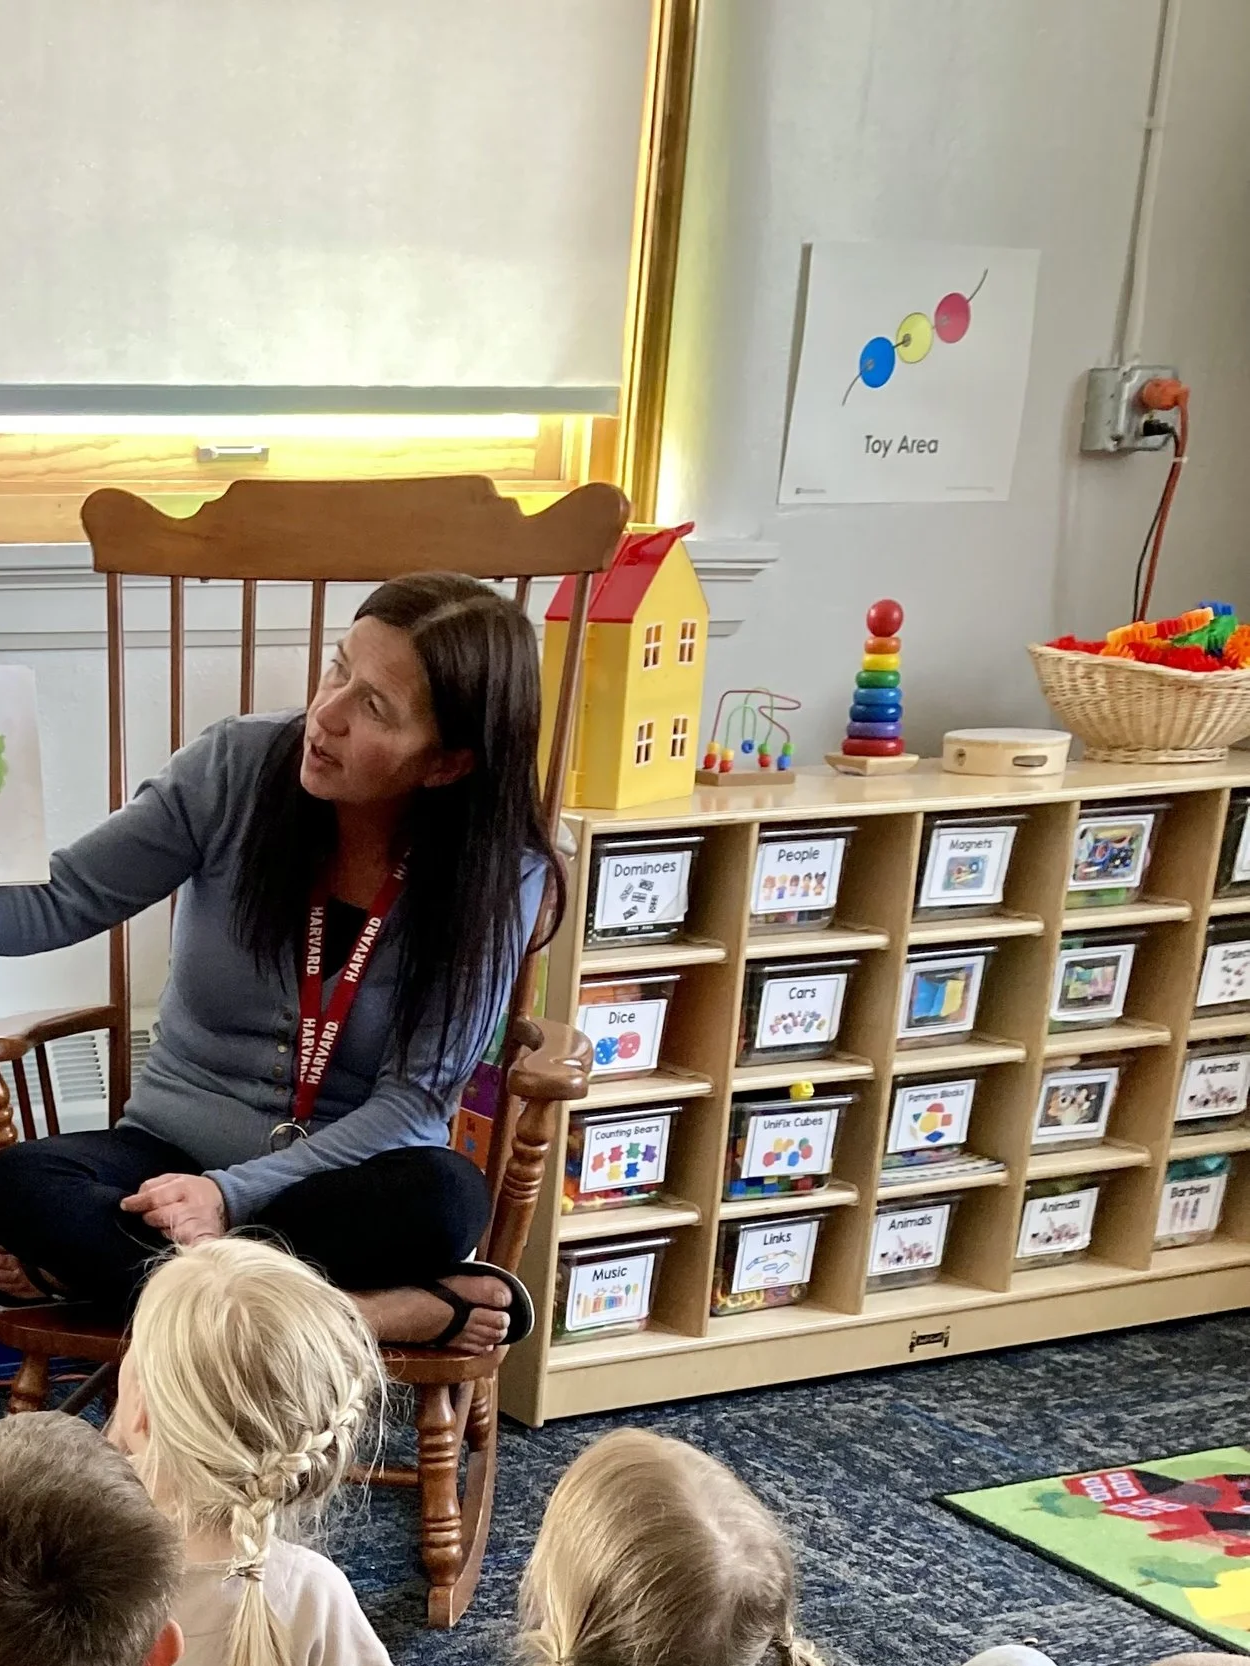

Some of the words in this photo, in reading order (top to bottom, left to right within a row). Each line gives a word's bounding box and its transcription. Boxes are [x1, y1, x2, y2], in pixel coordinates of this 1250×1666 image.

[865, 435, 893, 458] Toy
[897, 435, 939, 453] Area
[949, 840, 993, 852] Magnets
[777, 847, 820, 863] People
[614, 861, 677, 877] Dominoes
[307, 906, 324, 975] HARVARD
[344, 917, 382, 982] HARVARD
[788, 986, 817, 1000] Cars
[609, 1011, 636, 1024] Dice
[306, 1021, 339, 1085] HARVARD
[1197, 1060, 1240, 1076] Animals
[794, 1116, 823, 1127] Cubes
[595, 1128, 632, 1140] Counting
[634, 1125, 660, 1135] Bears
[1040, 1197, 1082, 1213] Animals
[888, 1213, 933, 1230] Animals
[763, 1232, 792, 1246] Links
[592, 1266, 628, 1282] Music
